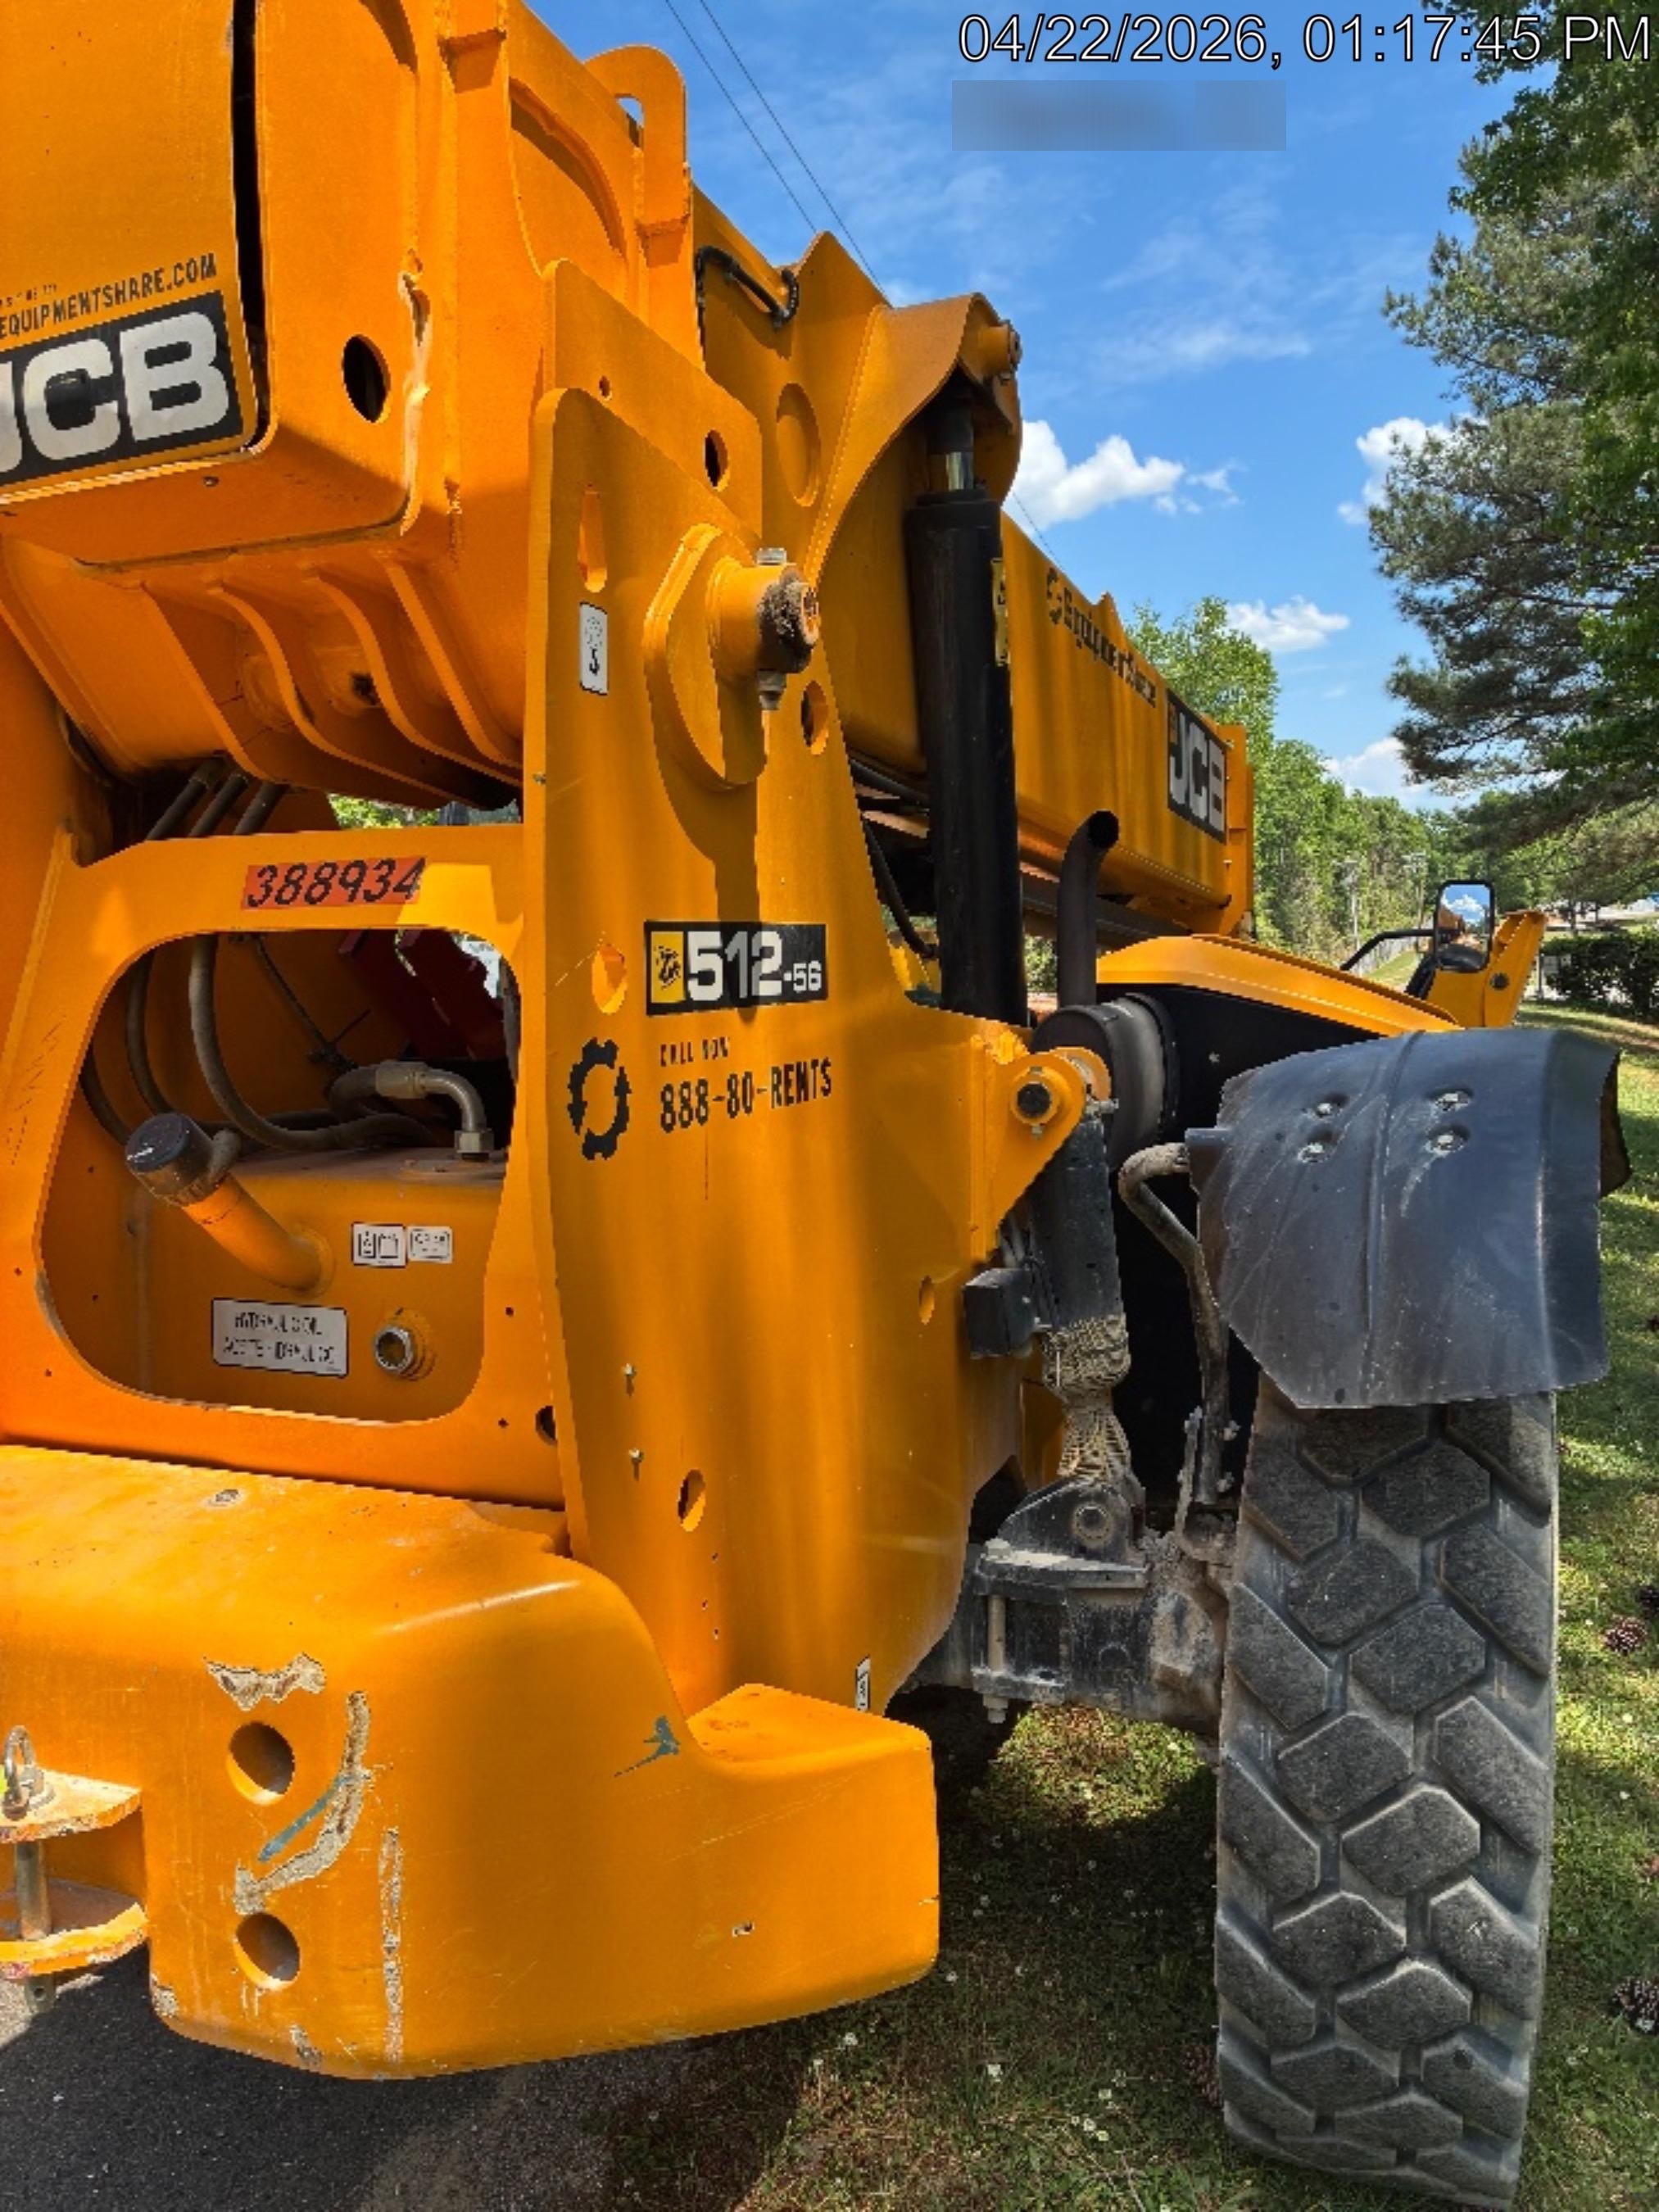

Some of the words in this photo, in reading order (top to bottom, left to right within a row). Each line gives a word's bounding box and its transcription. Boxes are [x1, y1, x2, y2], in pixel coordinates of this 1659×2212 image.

[0, 252, 217, 339] EQUIPMENTSHARE.COM
[1170, 711, 1227, 832] JCB
[247, 857, 426, 908] 388934
[660, 1056, 832, 1134] 888-80-RENTS
